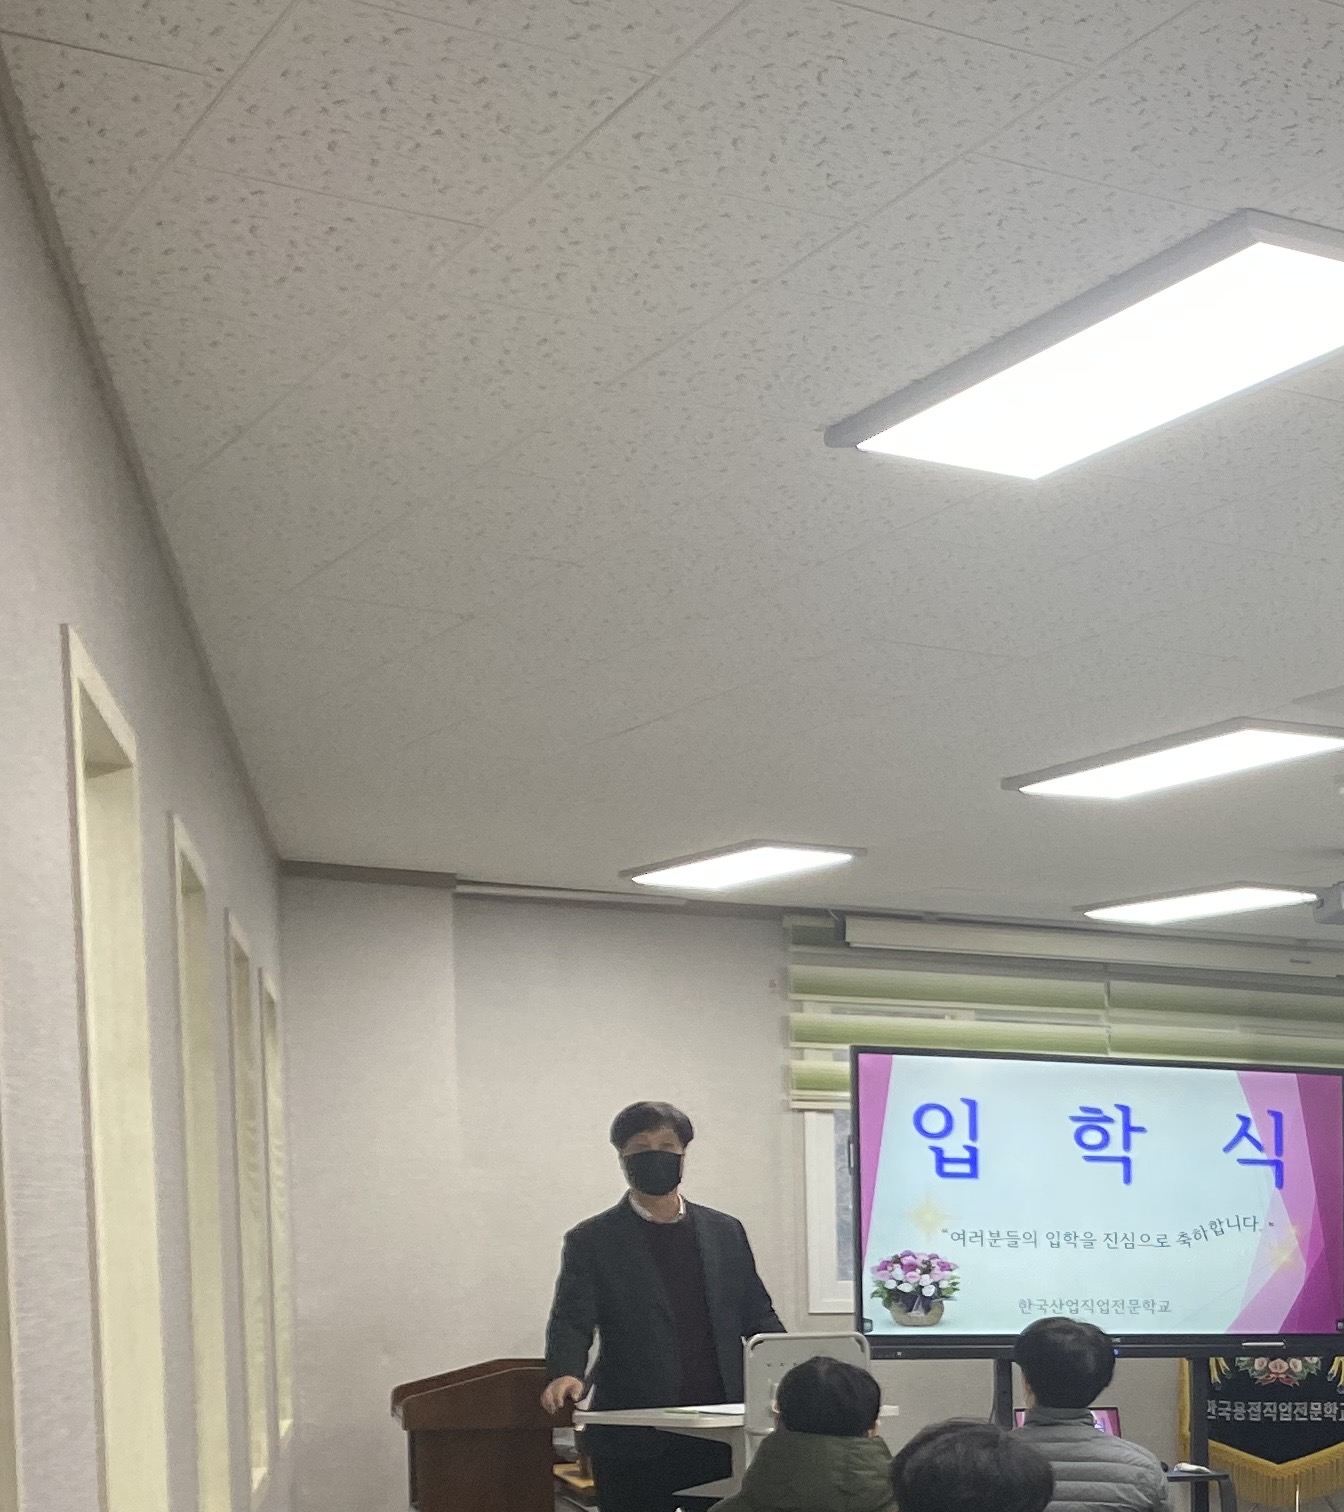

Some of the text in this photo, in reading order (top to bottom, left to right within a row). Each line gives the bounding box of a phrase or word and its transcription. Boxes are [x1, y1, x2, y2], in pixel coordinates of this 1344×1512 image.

[1045, 1229, 1098, 1250] 입학을
[1102, 1230, 1172, 1251] 진심으로
[1018, 1297, 1173, 1316] 한국산업직업전문학교
